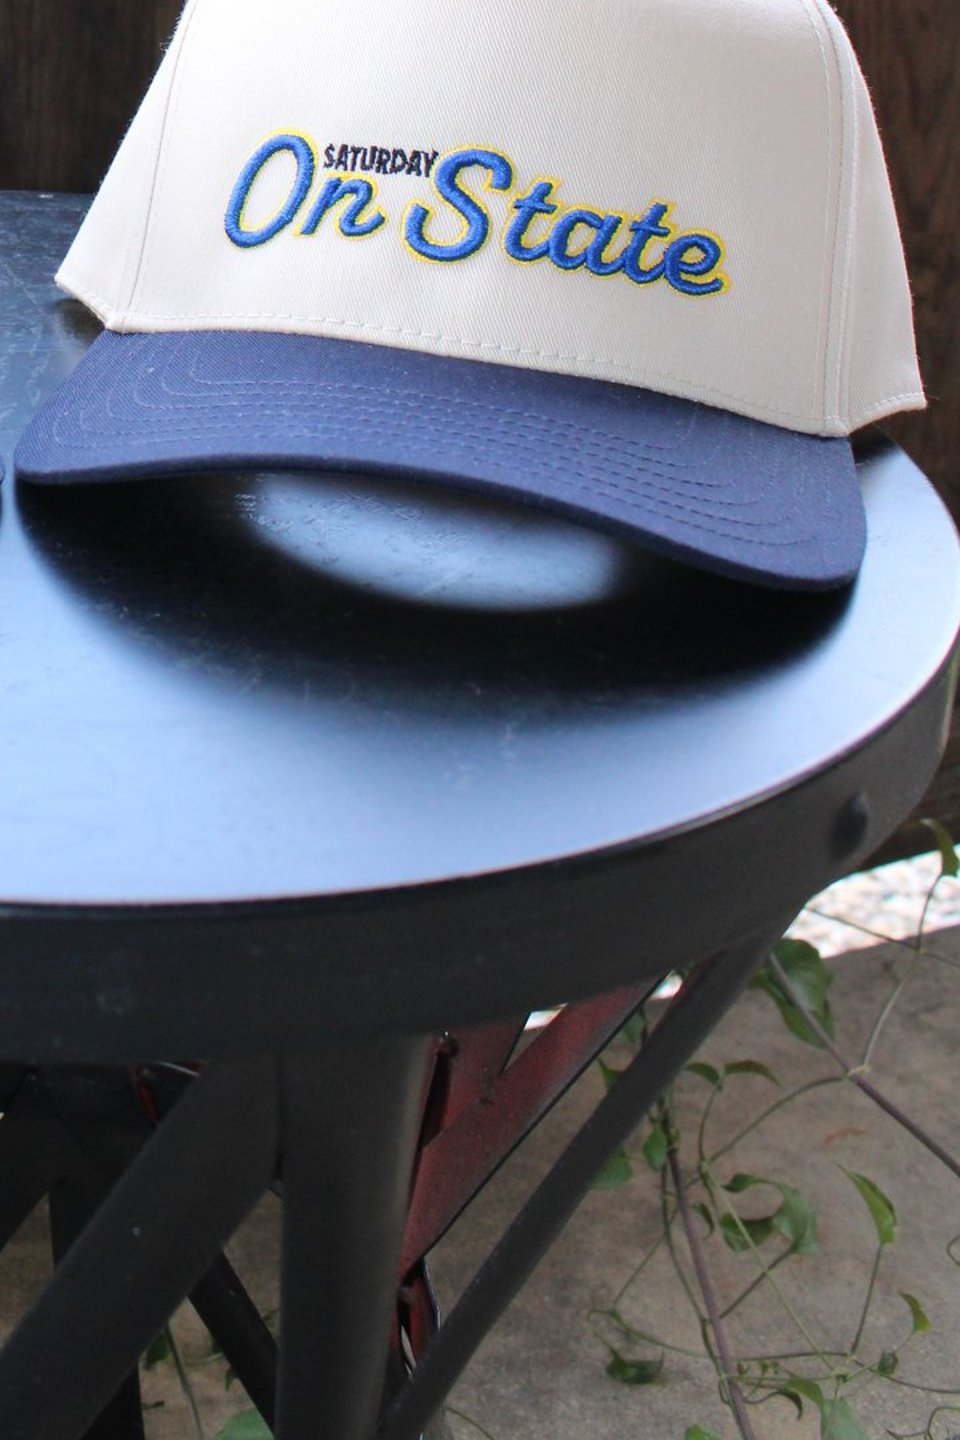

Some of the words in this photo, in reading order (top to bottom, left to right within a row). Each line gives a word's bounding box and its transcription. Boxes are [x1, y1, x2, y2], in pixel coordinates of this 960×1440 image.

[323, 143, 438, 177] SATURDAY
[224, 129, 387, 249] On
[401, 145, 730, 297] State
